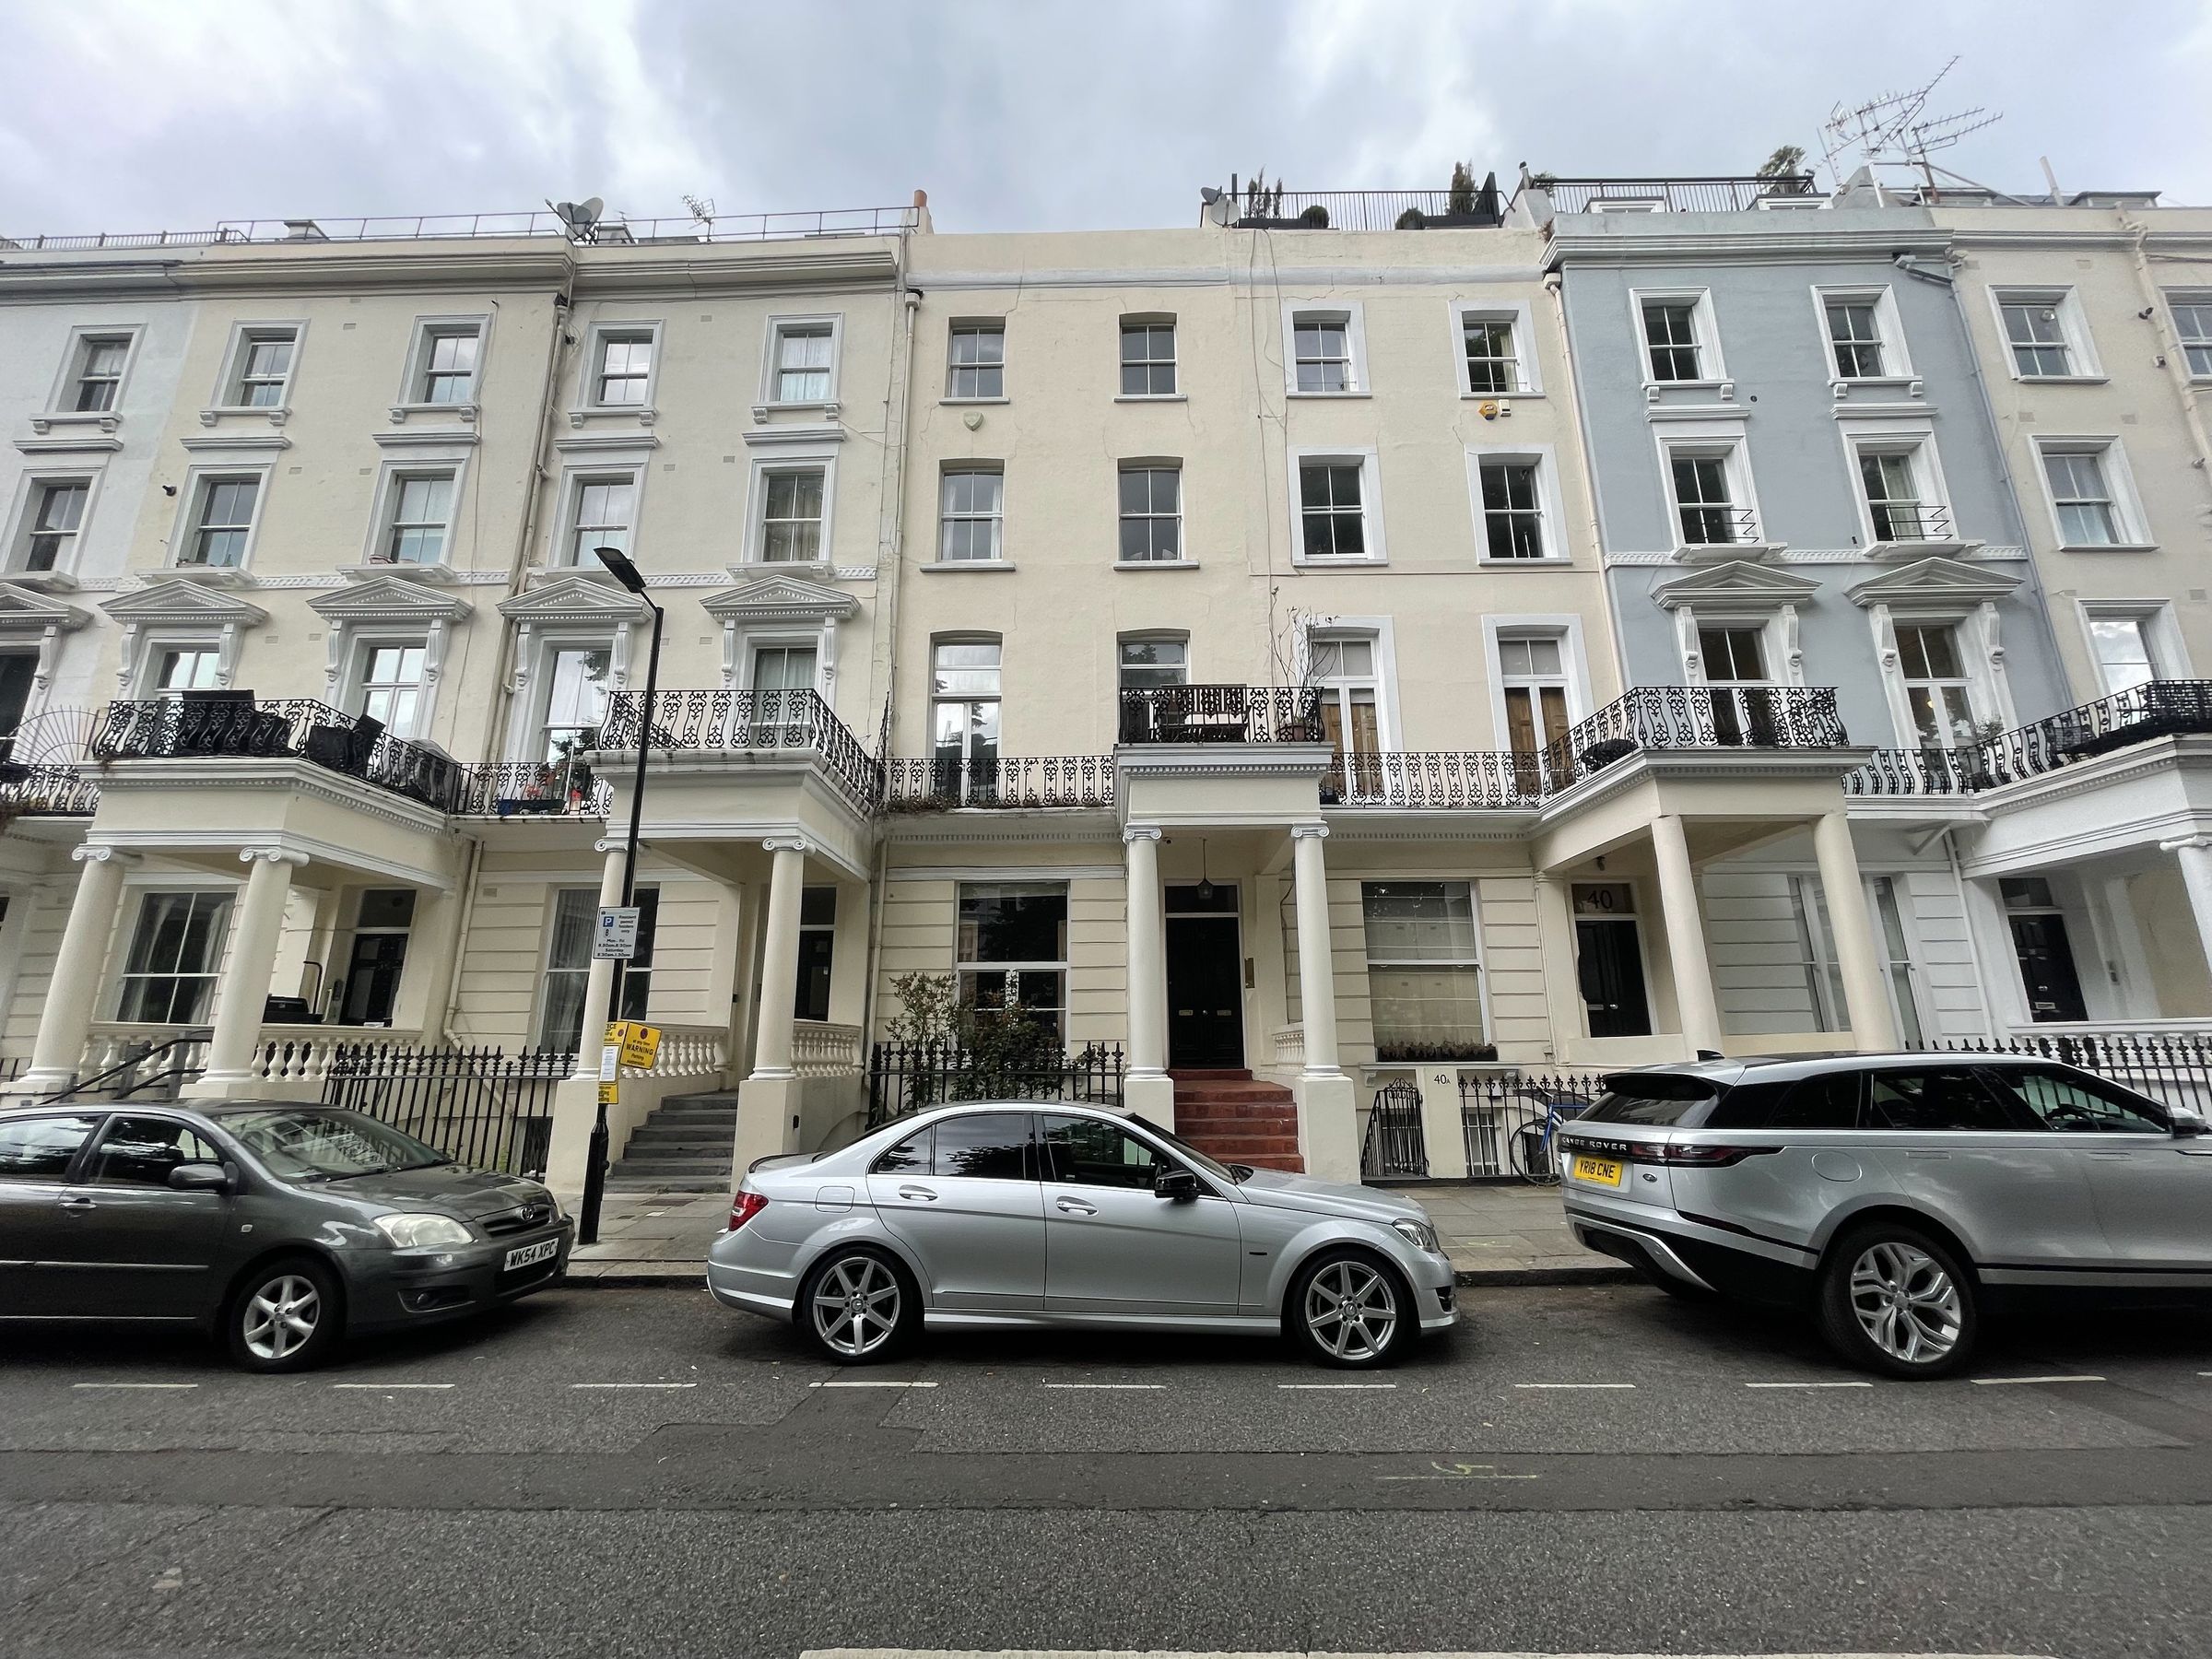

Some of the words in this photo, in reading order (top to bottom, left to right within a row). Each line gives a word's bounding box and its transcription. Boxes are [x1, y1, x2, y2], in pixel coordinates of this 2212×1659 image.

[1587, 889, 1613, 910] 40
[627, 1042, 653, 1055] WARNING
[1589, 1141, 1628, 1151] ROVER
[1579, 1159, 1596, 1175] YR18
[1596, 1162, 1616, 1179] CNE
[510, 1248, 535, 1267] WK54
[538, 1241, 555, 1258] XPC
